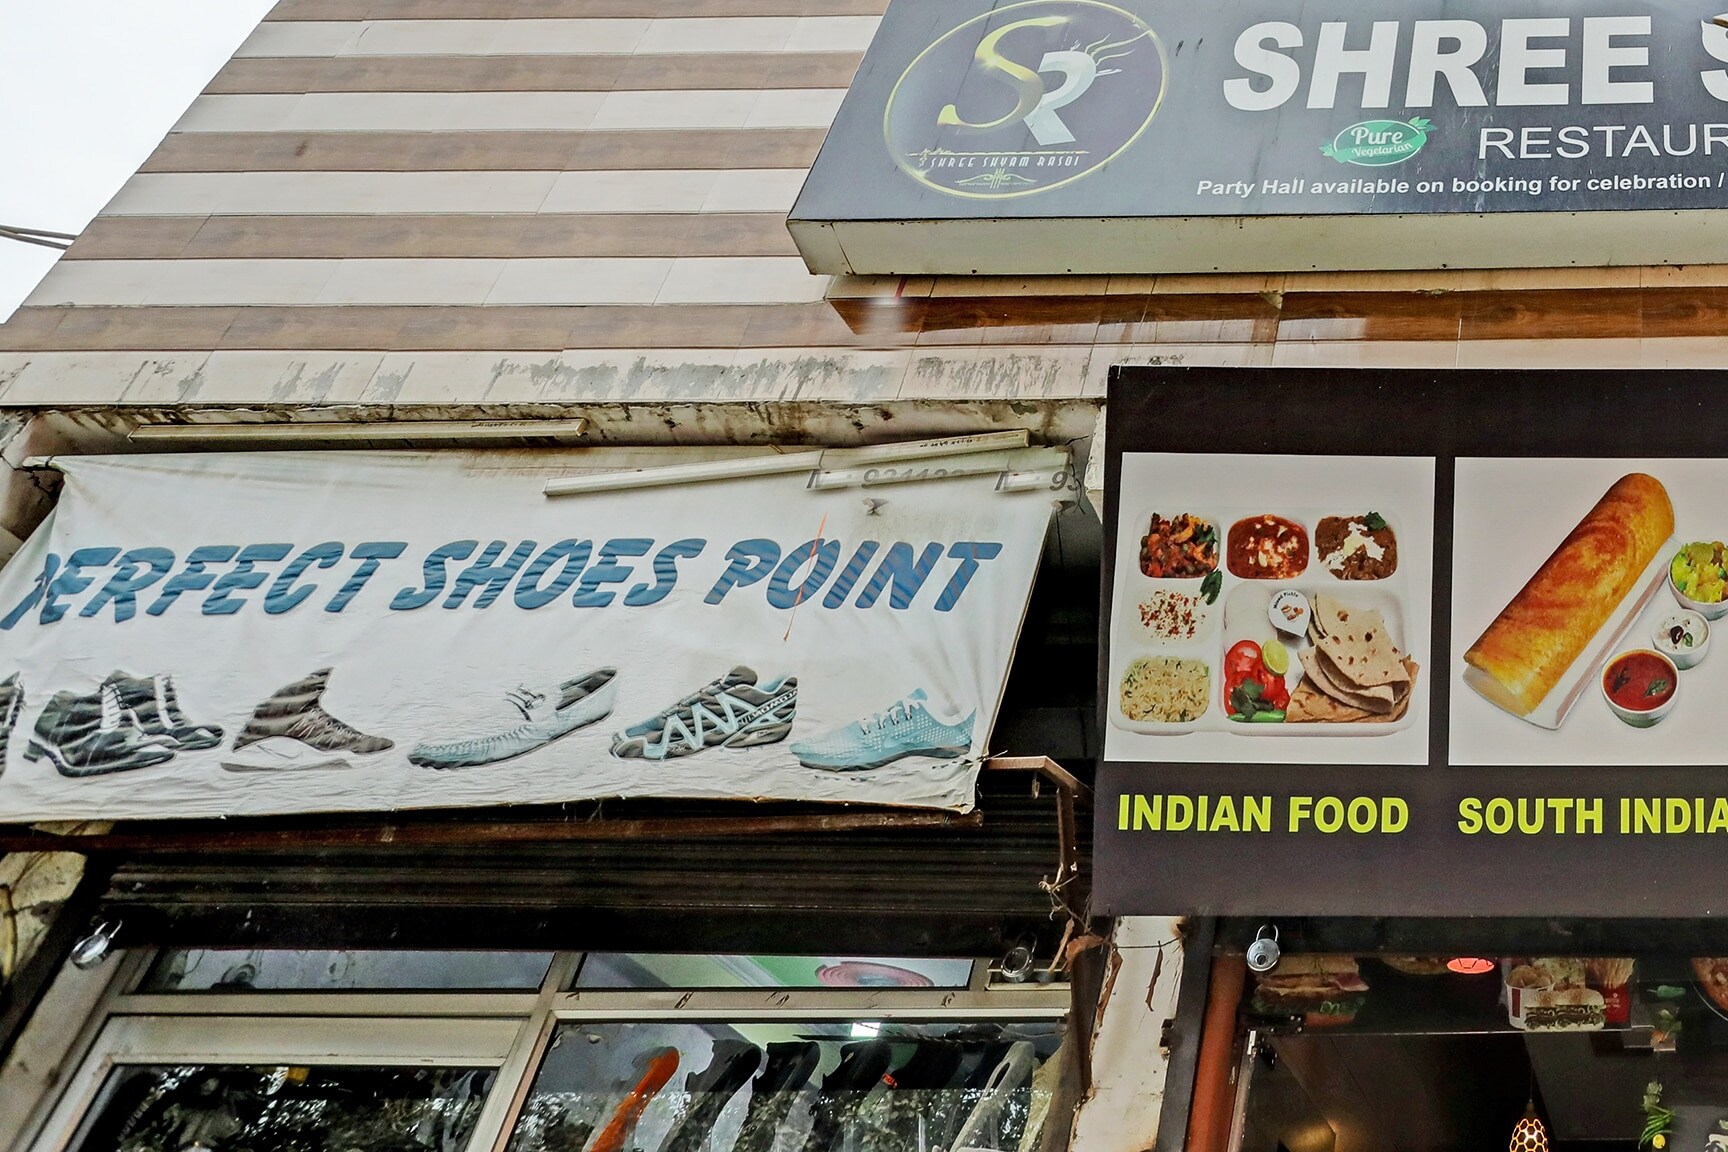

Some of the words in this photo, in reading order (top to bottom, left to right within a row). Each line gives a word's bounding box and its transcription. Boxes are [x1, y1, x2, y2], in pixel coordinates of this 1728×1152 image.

[1223, 15, 1655, 112] SHREE
[1350, 126, 1403, 145] Pure
[1351, 142, 1413, 158] Vegetarian
[1197, 179, 1256, 198] Party
[1261, 177, 1304, 194] Hall
[1310, 175, 1409, 194] available
[1416, 179, 1444, 193] on
[1452, 176, 1541, 196] booking
[1549, 175, 1580, 192] for
[1587, 172, 1711, 191] celebration
[399, 537, 707, 612] SHOES
[703, 537, 1003, 613] POINT
[1118, 794, 1271, 832] INDIAN
[1288, 796, 1409, 833] FOOD
[1457, 797, 1603, 834] SOUTH
